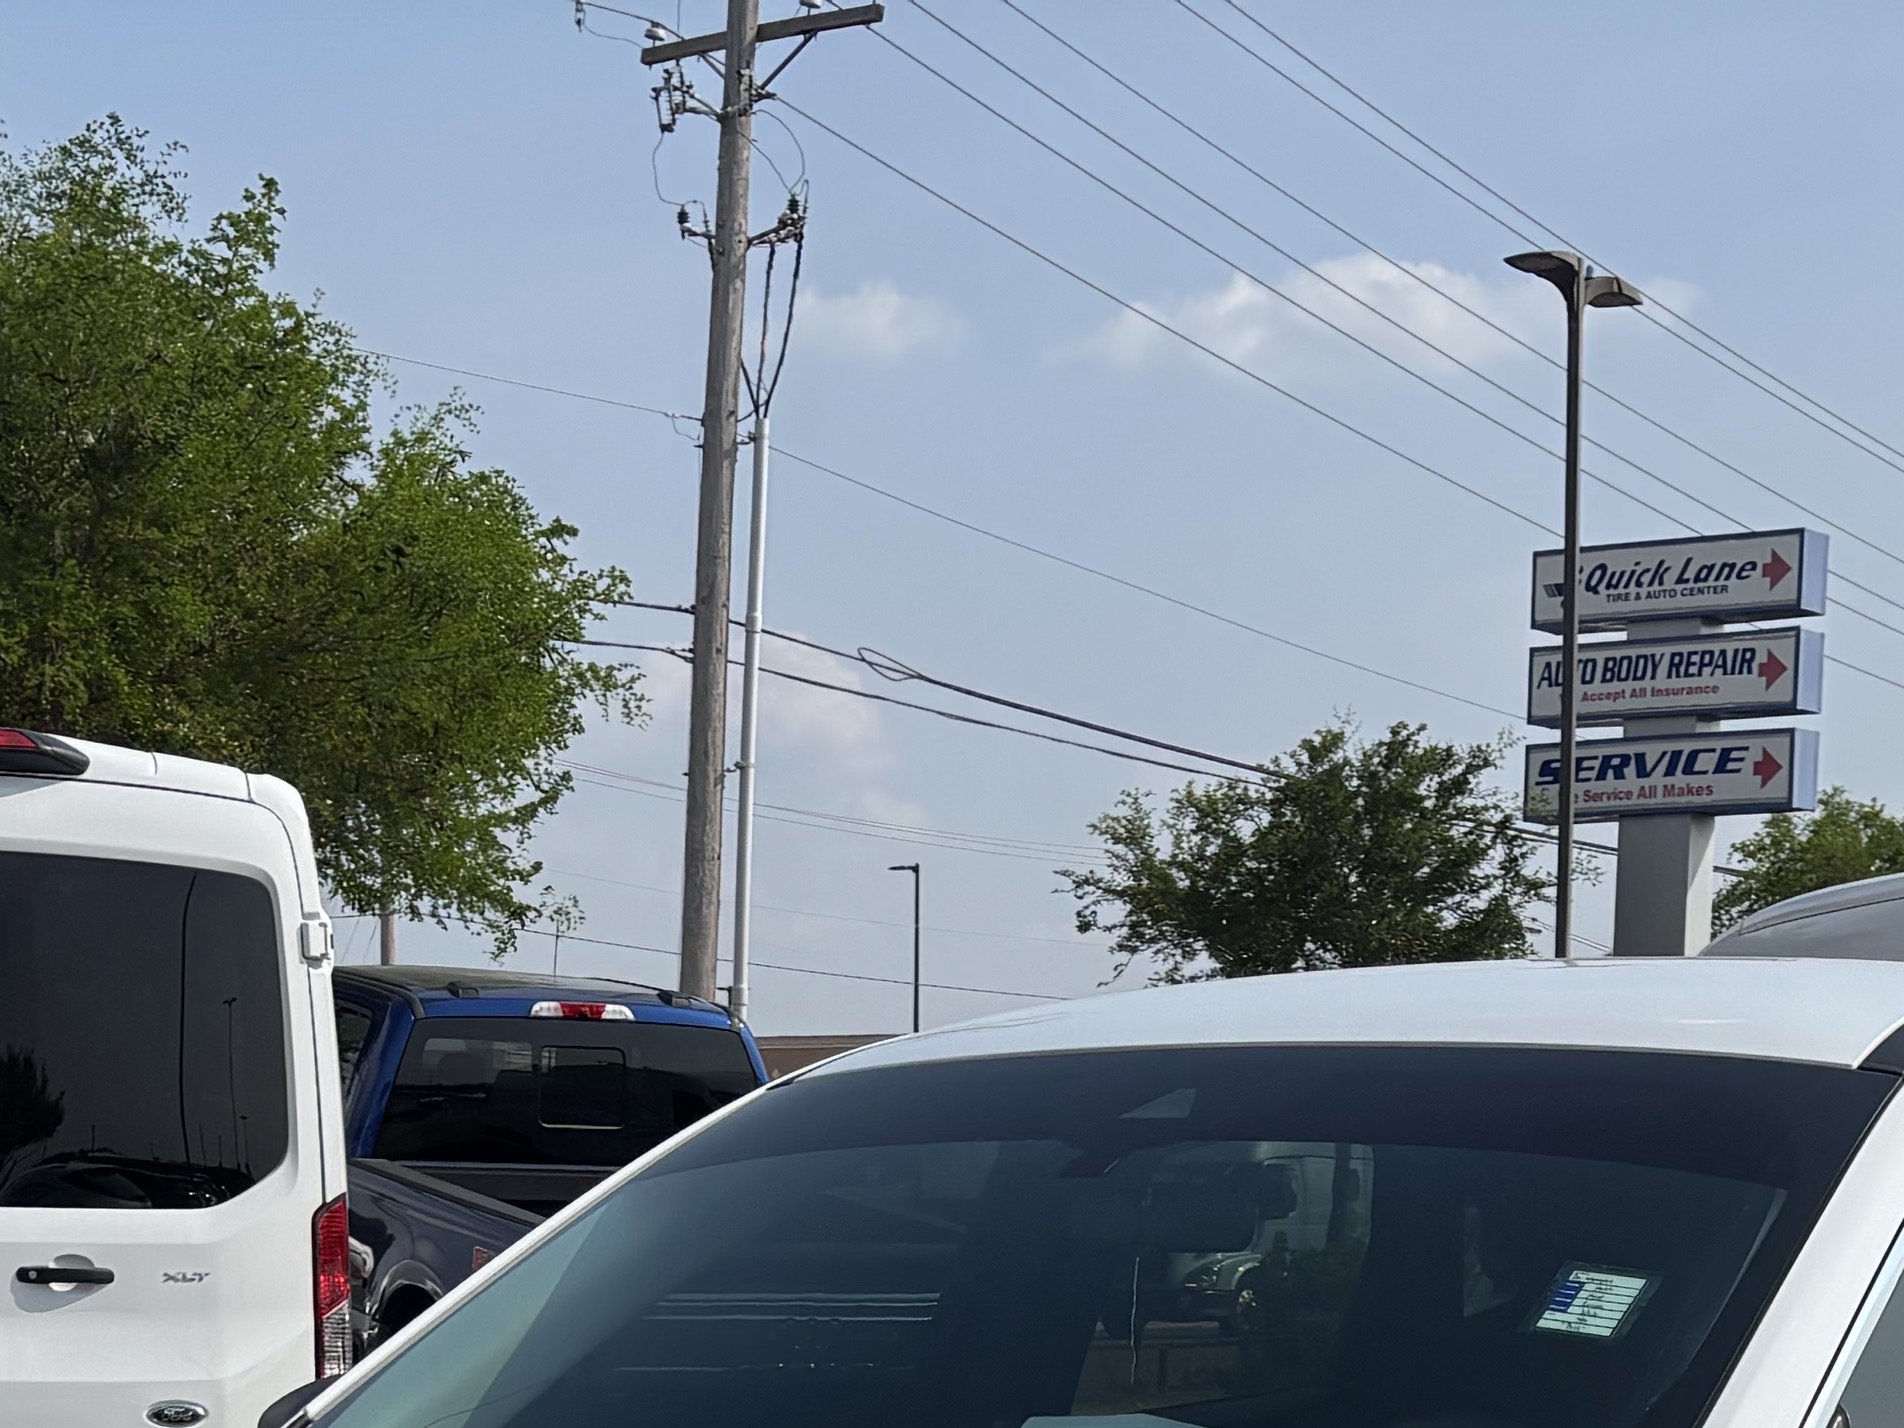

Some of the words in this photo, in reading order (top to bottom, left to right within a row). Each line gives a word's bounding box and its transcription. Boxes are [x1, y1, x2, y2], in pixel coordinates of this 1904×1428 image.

[1584, 558, 1672, 595] Quick
[1674, 556, 1758, 586] Lane
[1605, 593, 1632, 603] TIRE
[1633, 592, 1642, 602] &
[1644, 589, 1678, 600] AUTO
[1679, 584, 1729, 597] CENTER
[1599, 651, 1666, 685] BODY
[1666, 646, 1757, 679] REPAIR
[1580, 688, 1627, 703] Accept
[1629, 686, 1647, 699] All
[1650, 684, 1720, 698] Insurance
[1534, 745, 1750, 786] SERVICE
[1583, 788, 1633, 803] Service
[1637, 783, 1658, 799] All
[1662, 783, 1714, 798] Makes
[161, 1271, 211, 1284] XLT
